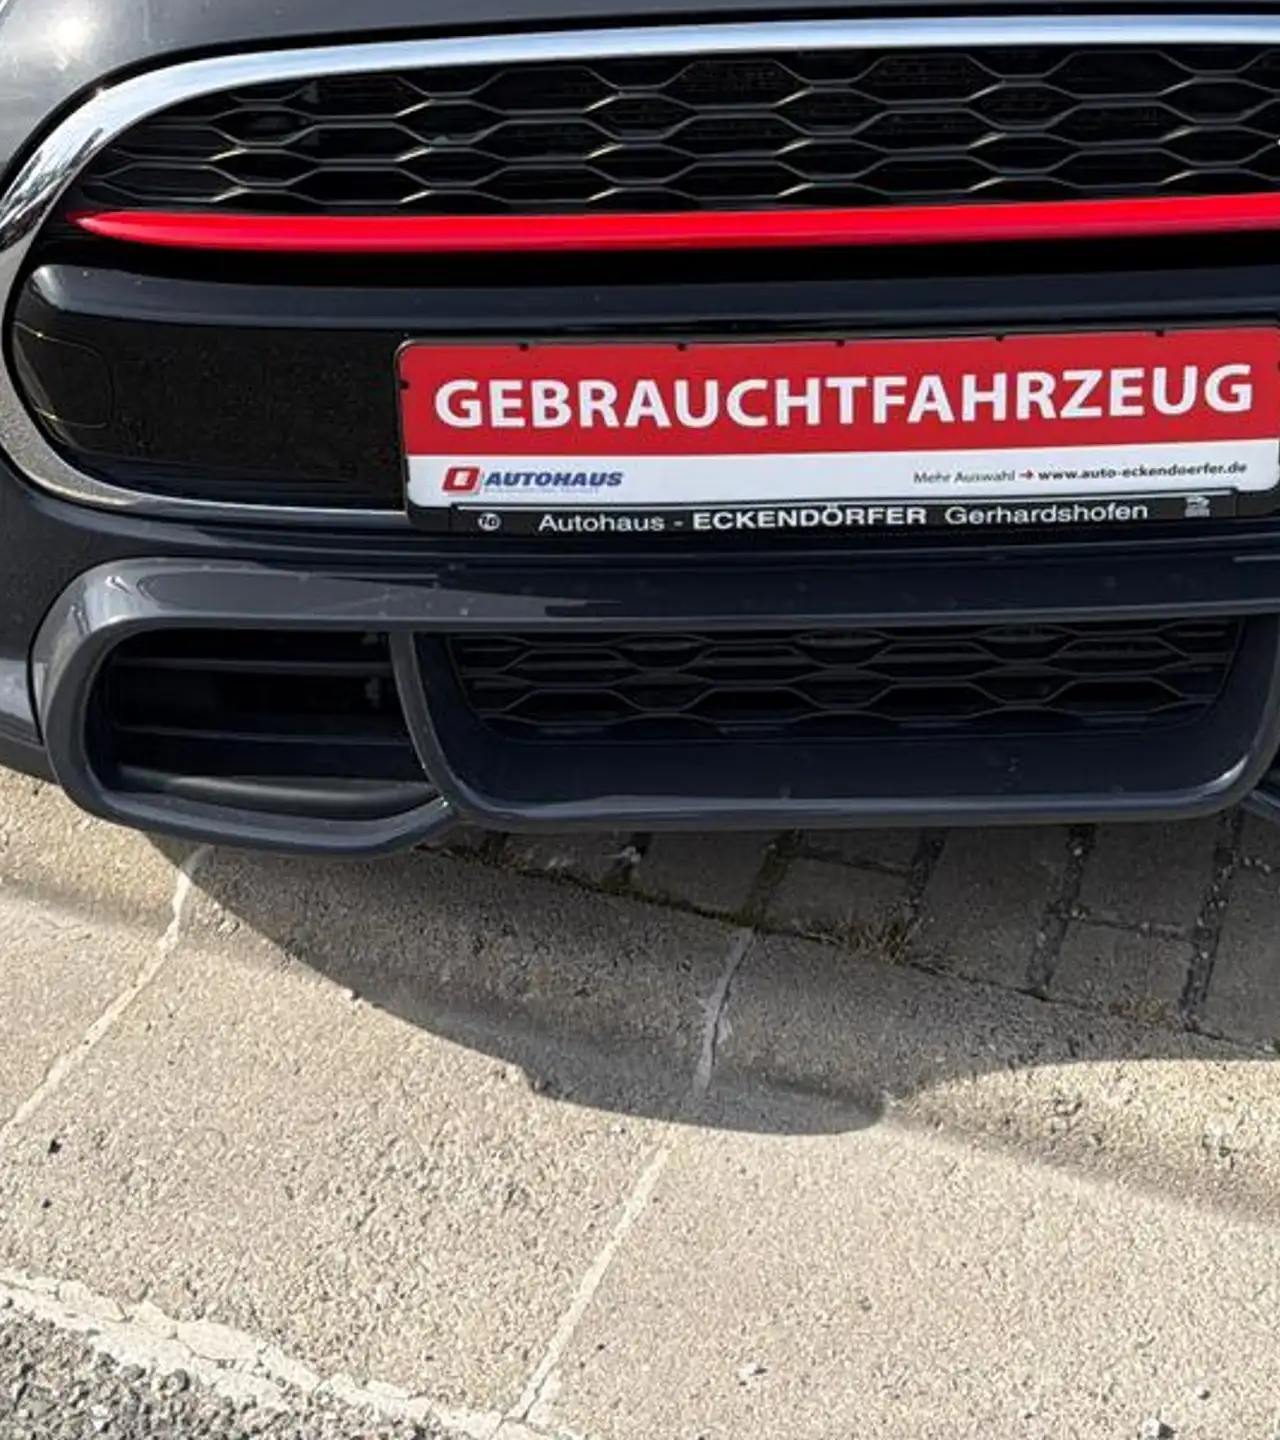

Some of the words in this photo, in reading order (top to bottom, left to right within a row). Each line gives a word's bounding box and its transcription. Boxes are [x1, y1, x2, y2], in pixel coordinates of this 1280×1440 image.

[434, 363, 1253, 429] GEBRAUCHTFAHRZEUG
[485, 471, 624, 487] AUTOHAUS
[913, 471, 950, 484] Mehr
[954, 469, 1015, 483] Auswahl
[1038, 461, 1247, 481] www.auto-eckendoerfer.de
[538, 513, 665, 533] Autohaus
[693, 503, 927, 531] ECKENDÖRFER
[944, 501, 1148, 526] Gerhardshofen
